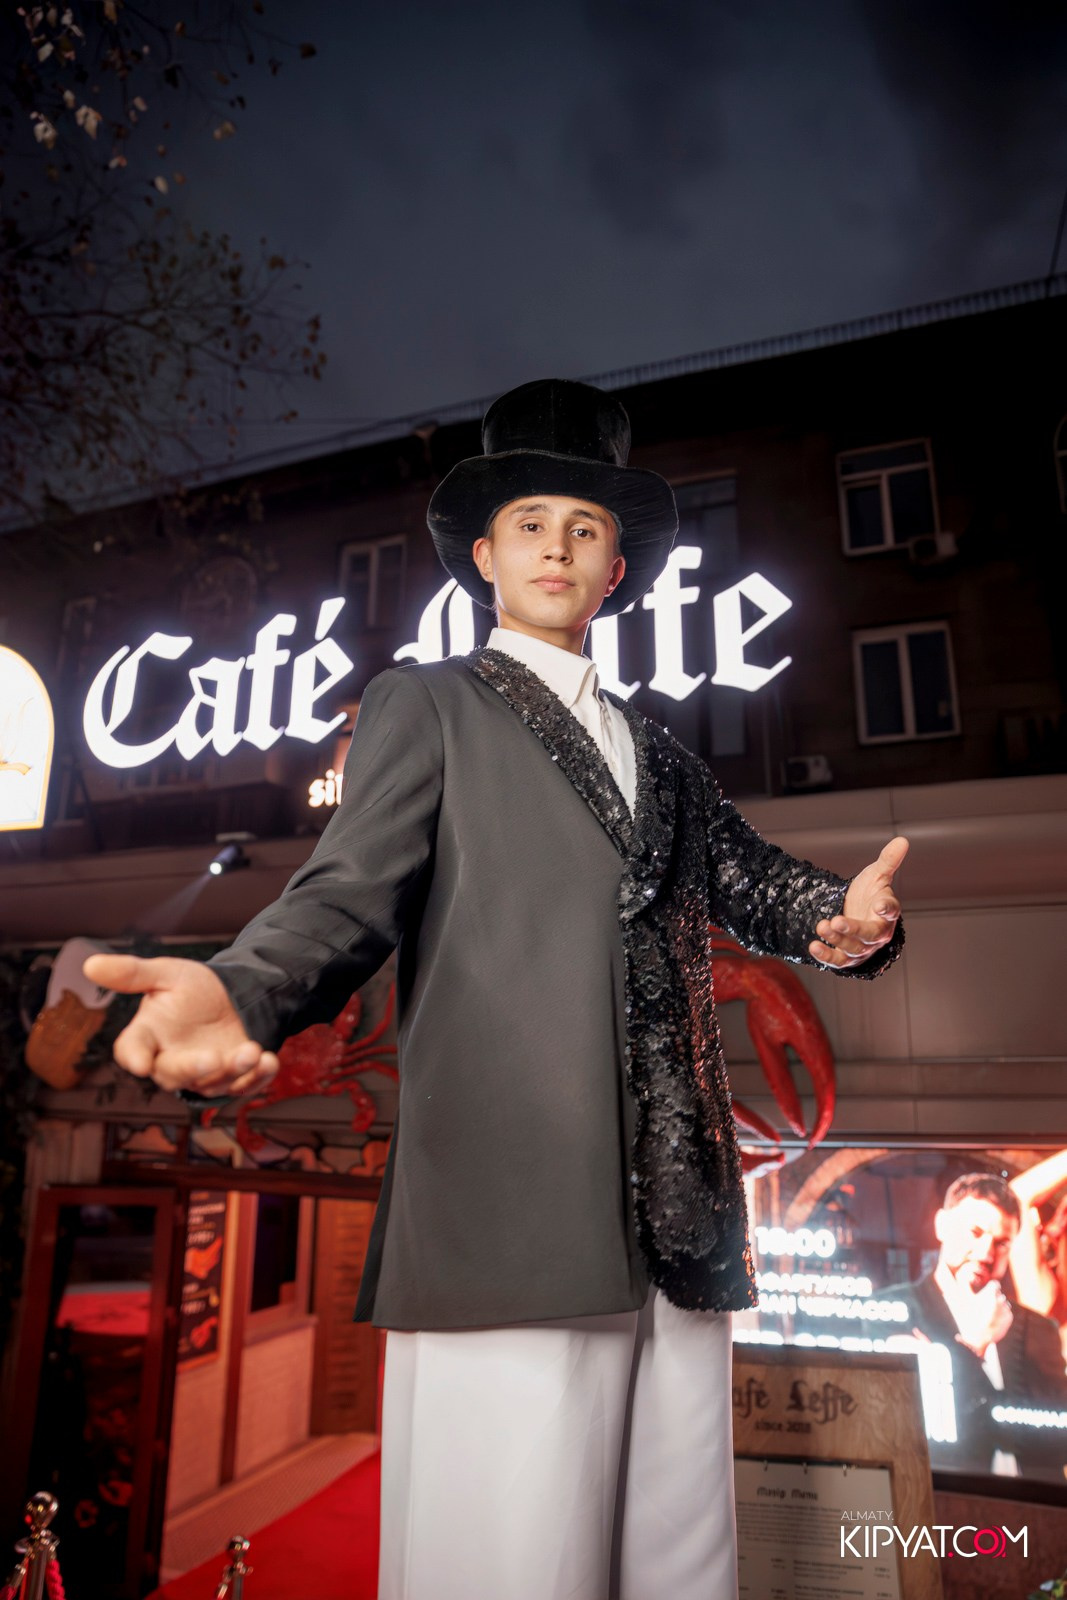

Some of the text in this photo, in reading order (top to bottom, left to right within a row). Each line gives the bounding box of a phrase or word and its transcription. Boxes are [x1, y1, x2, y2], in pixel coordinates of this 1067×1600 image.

[83, 596, 354, 768] Café
[733, 1377, 859, 1426] afé Leffe
